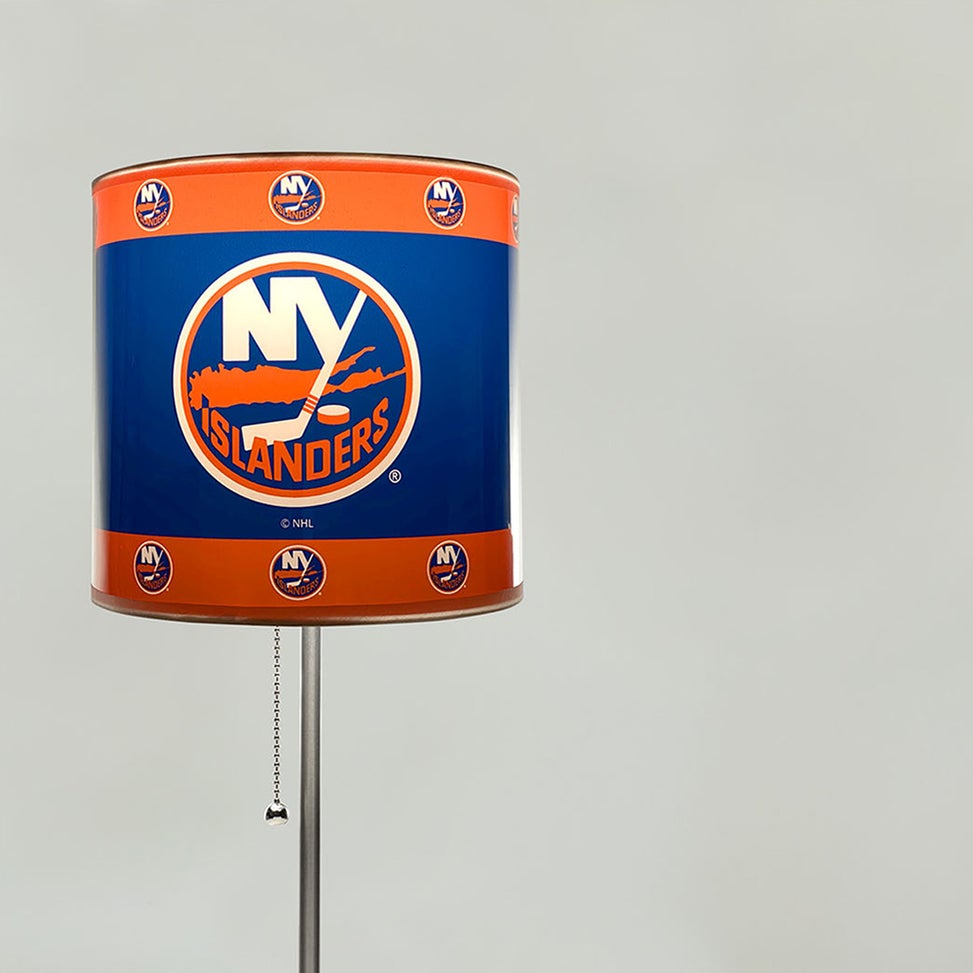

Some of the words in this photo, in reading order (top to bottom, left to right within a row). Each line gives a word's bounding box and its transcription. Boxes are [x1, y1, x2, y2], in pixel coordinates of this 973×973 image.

[141, 183, 164, 203] NY
[280, 175, 313, 195] NY
[433, 181, 458, 201] NY
[222, 276, 369, 365] NY
[201, 393, 389, 482] ISLANDERS
[292, 518, 314, 528] NHL
[281, 550, 314, 570] NY
